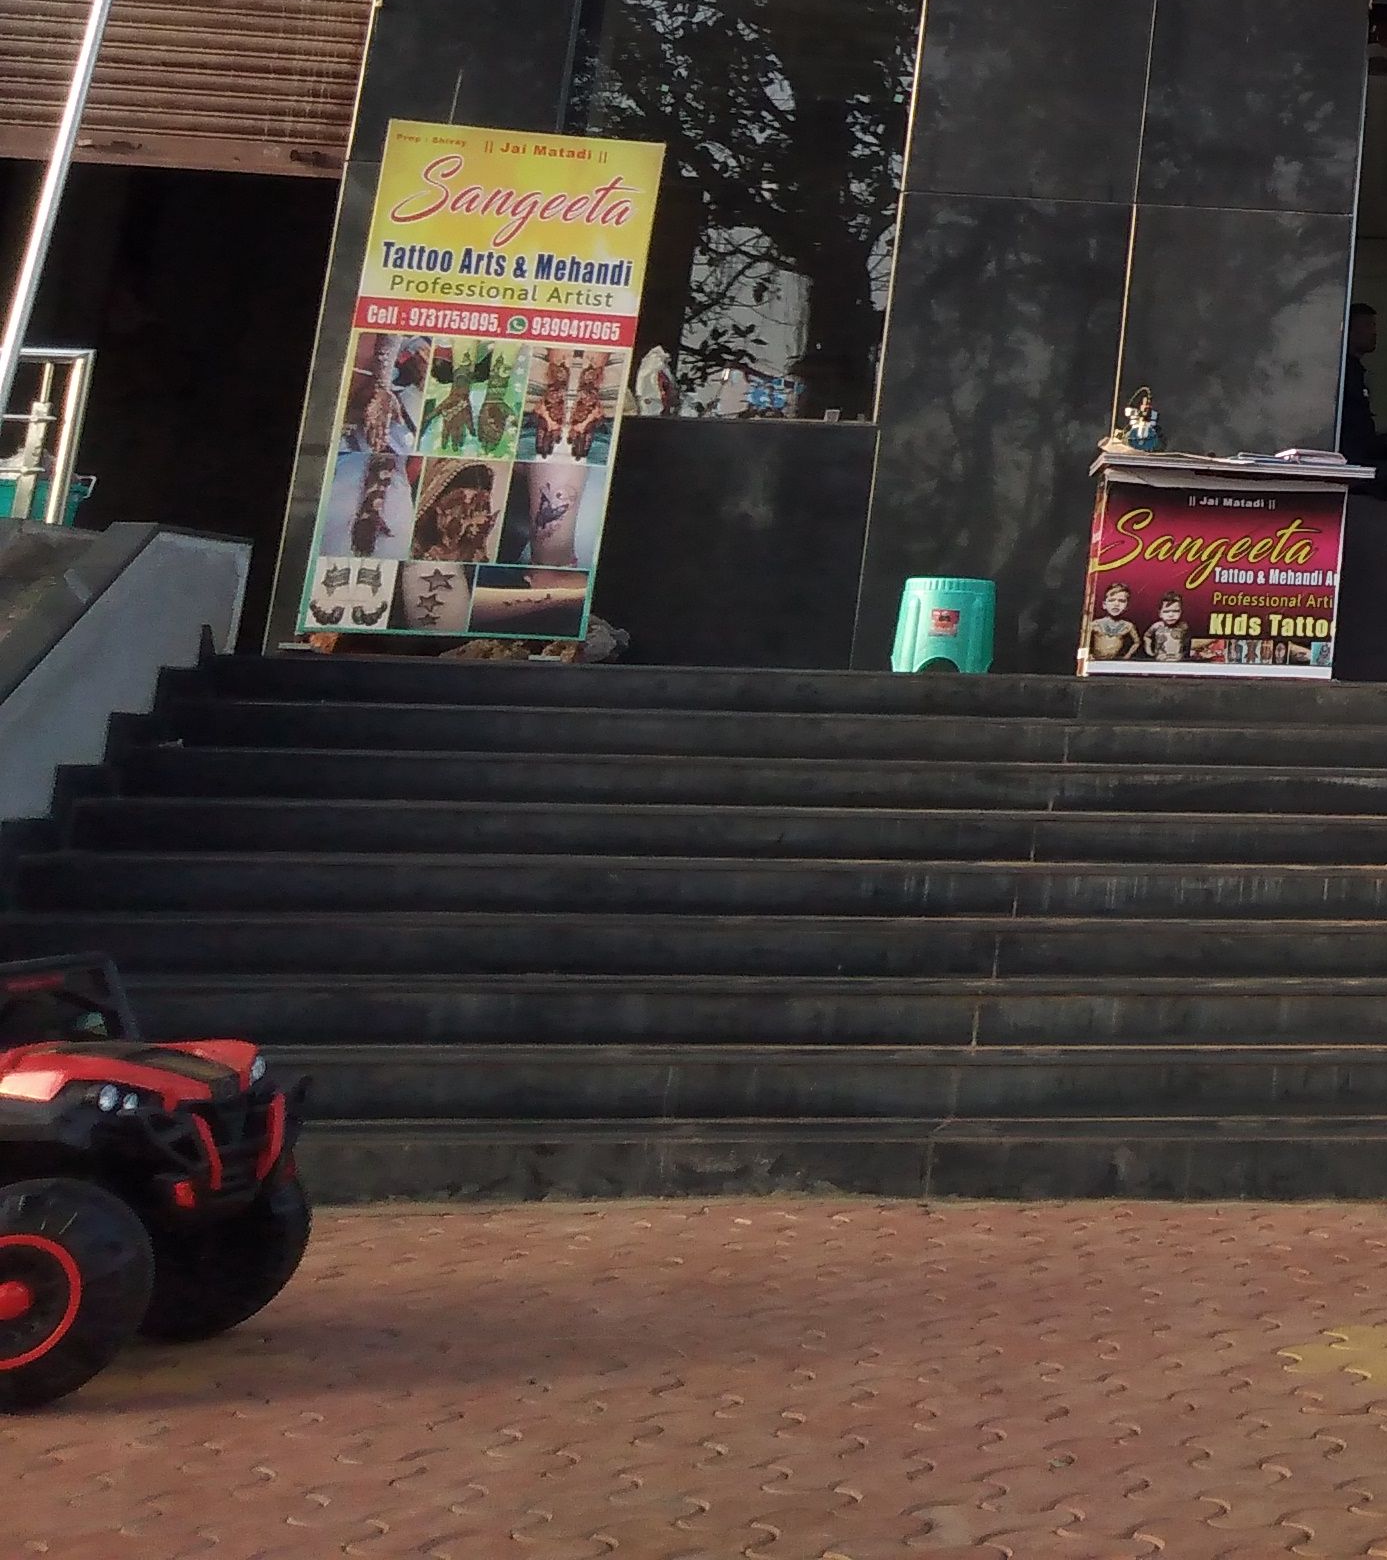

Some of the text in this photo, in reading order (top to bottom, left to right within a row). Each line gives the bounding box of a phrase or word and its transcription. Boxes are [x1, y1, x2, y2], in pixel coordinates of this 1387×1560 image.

[499, 141, 527, 155] Jai
[533, 144, 593, 160] Matadi
[390, 155, 639, 247] Sangeeta
[382, 241, 633, 287] Tattoo Arts & Mehandi
[390, 274, 613, 308] Professional Artist
[367, 304, 398, 325] Cell
[531, 316, 622, 341] 9399417965
[1199, 496, 1220, 507] Jai
[1223, 497, 1265, 509] Matadi
[1091, 508, 1322, 589] Sangeeta
[1214, 566, 1254, 585] Tattoo
[1256, 570, 1266, 584] &
[1268, 568, 1323, 586] Mehandi
[1213, 591, 1301, 608] Professional
[1208, 612, 1262, 636] Kids
